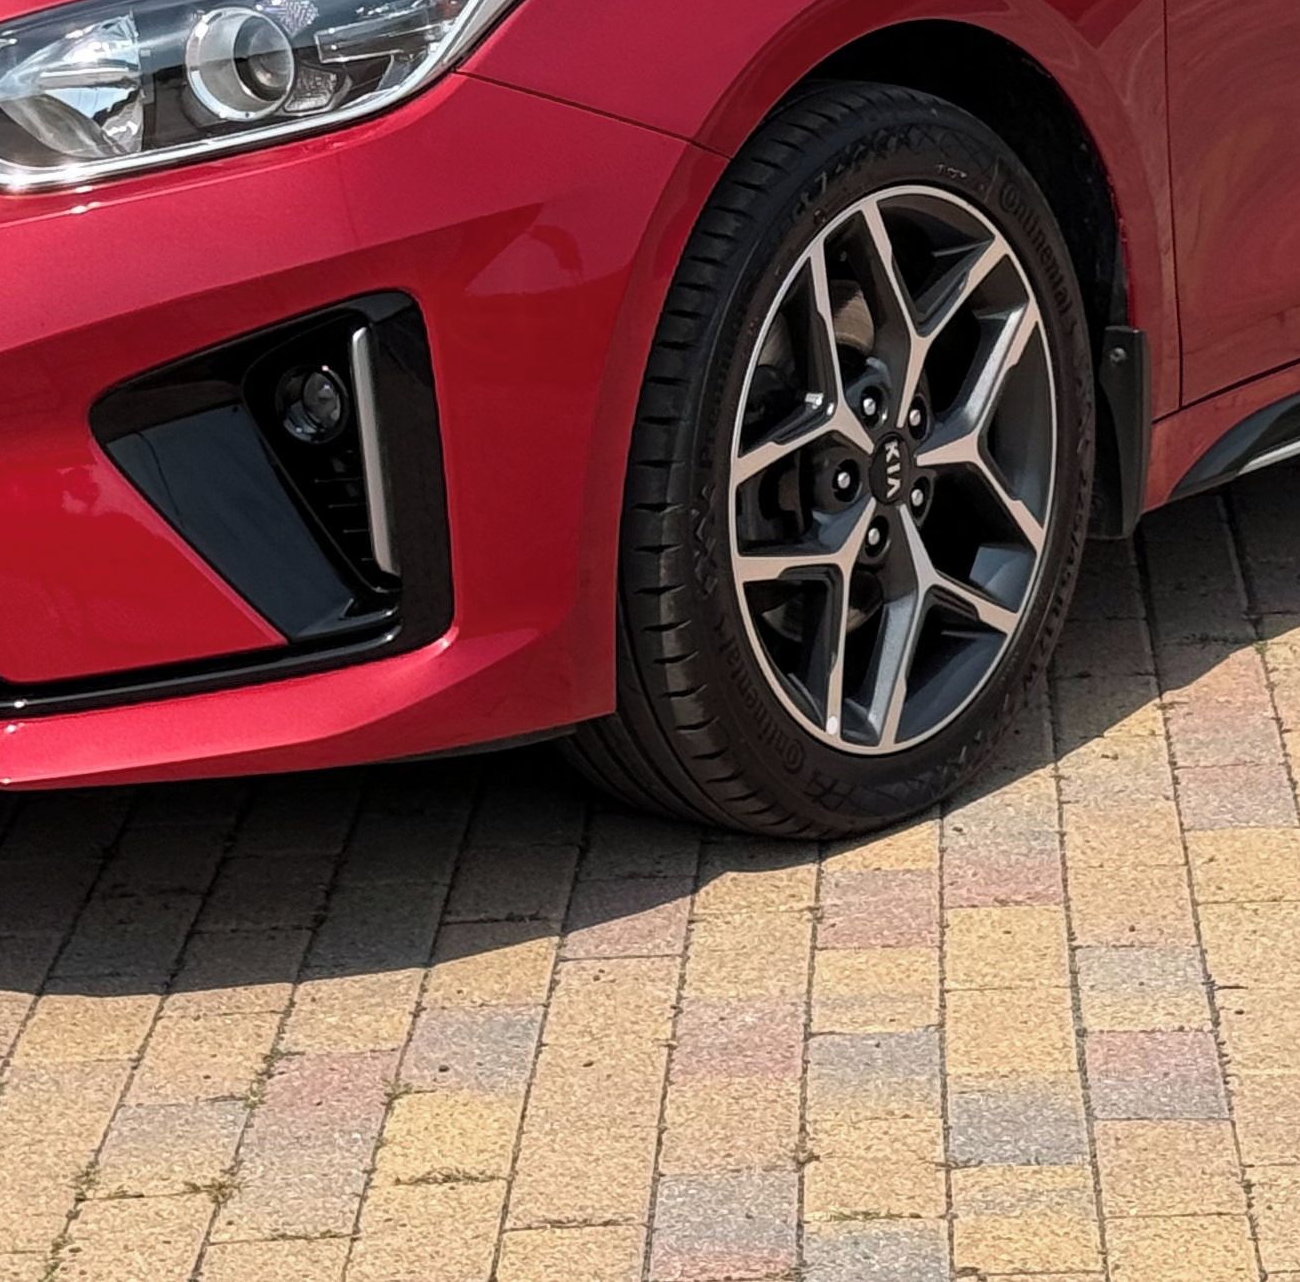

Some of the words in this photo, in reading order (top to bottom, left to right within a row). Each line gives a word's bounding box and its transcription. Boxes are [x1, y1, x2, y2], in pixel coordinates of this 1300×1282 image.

[1000, 182, 1074, 316] Continental
[884, 438, 901, 499] KIA
[718, 635, 807, 775] Continental
